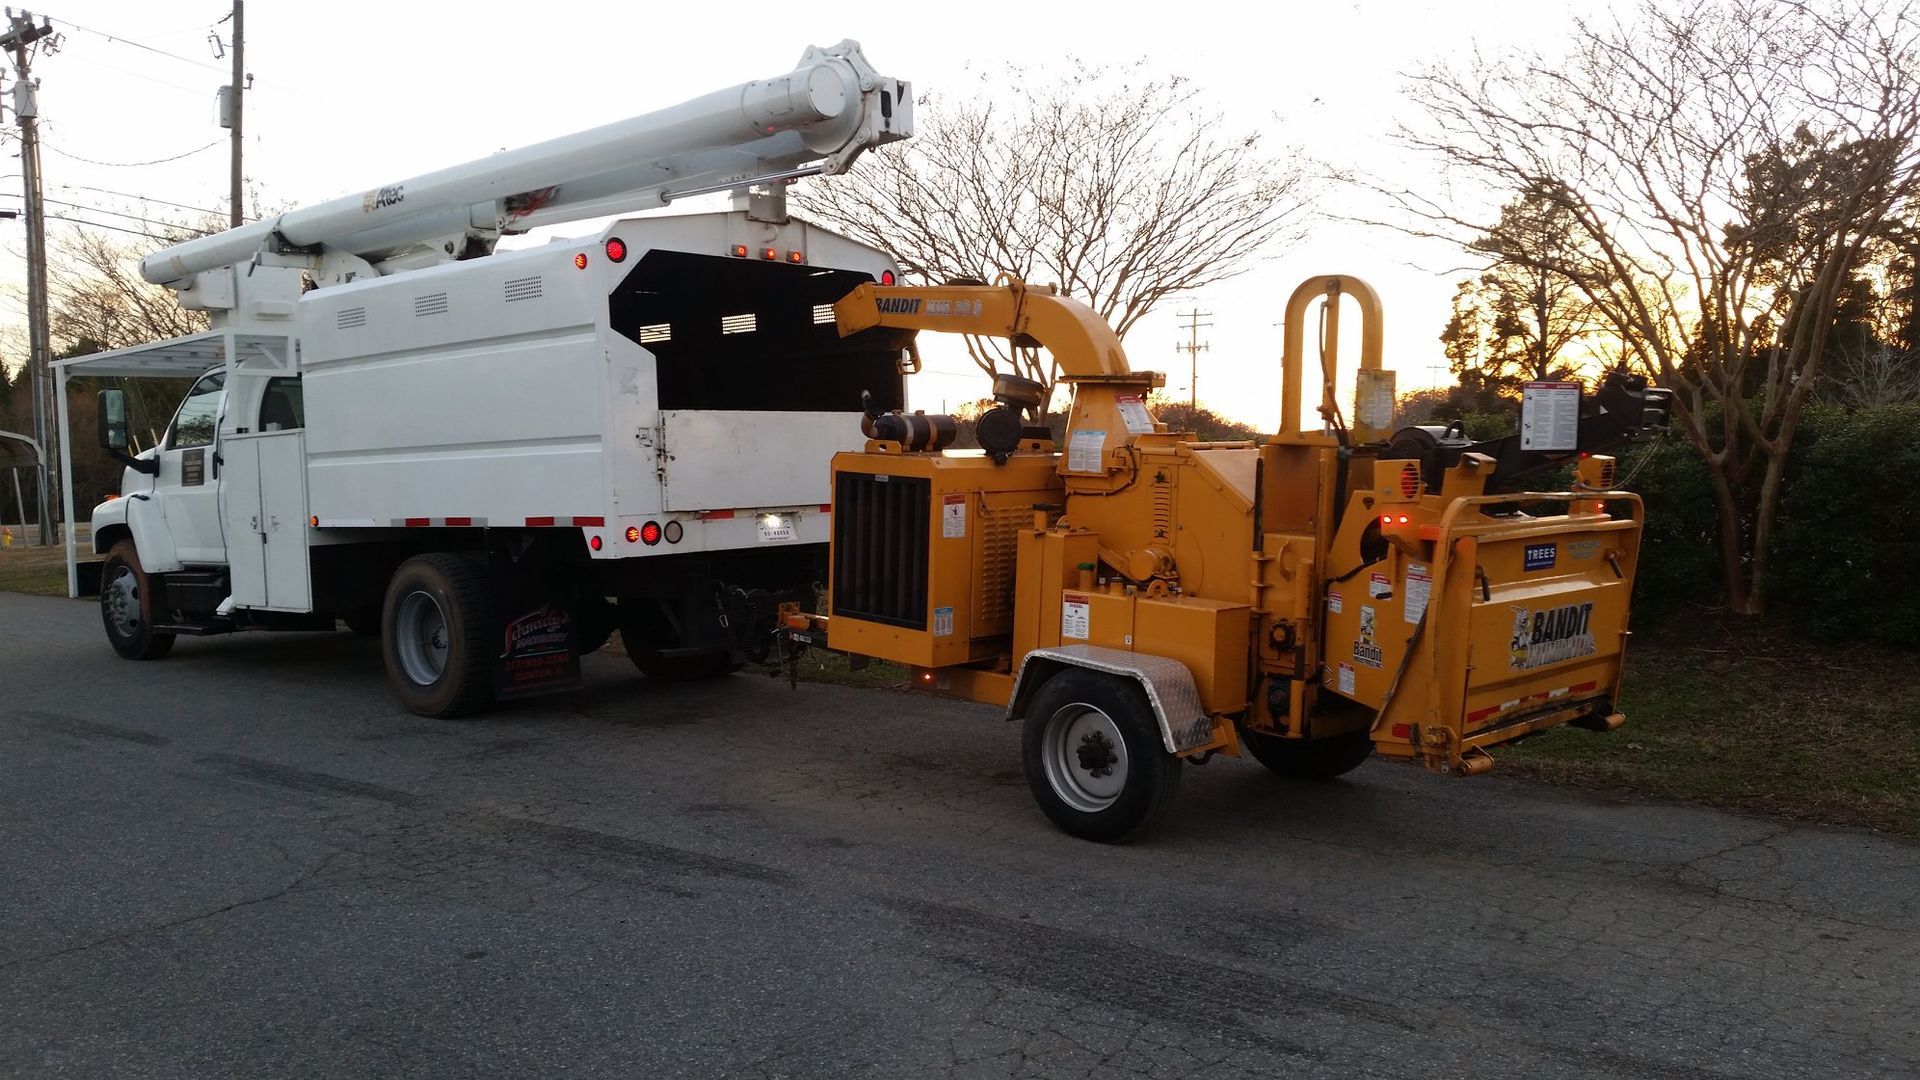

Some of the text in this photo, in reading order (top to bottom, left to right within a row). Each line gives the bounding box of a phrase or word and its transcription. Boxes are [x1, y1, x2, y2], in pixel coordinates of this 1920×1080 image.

[875, 298, 921, 313] BANDIT
[1527, 547, 1556, 561] TREES
[1531, 602, 1593, 645] BANDIT
[1354, 640, 1383, 662] Bandit
